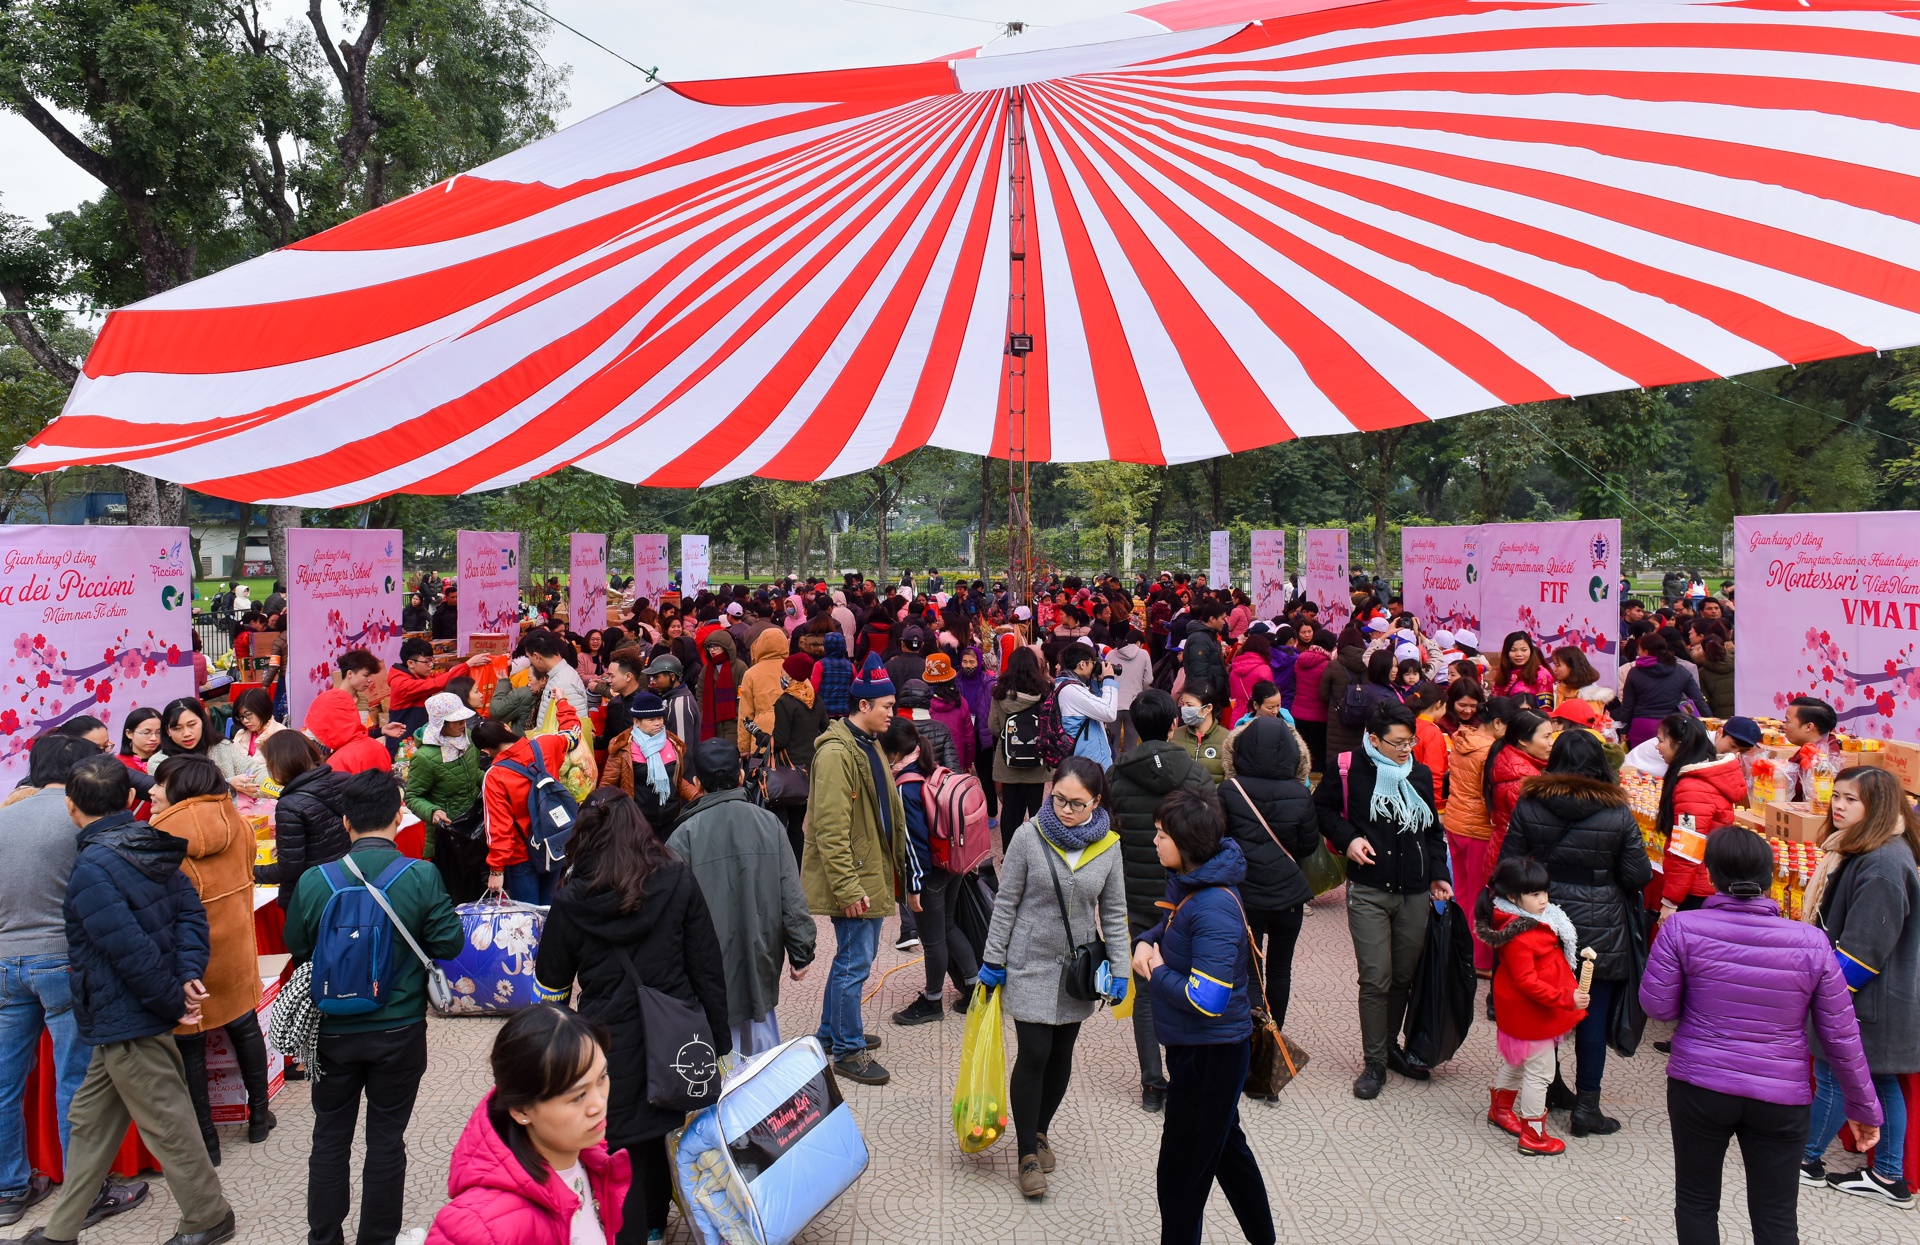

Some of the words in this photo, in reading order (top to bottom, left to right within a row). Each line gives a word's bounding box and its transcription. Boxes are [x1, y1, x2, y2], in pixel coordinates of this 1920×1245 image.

[1750, 531, 1771, 553] Gian
[1771, 531, 1793, 551] hàng
[1802, 531, 1824, 551] đồng
[4, 549, 34, 574] Gian
[35, 549, 62, 570] hàng
[73, 549, 97, 569] đồng
[1491, 555, 1515, 577] Trường
[1532, 563, 1545, 573] non
[1796, 551, 1817, 568] Trung
[1817, 555, 1831, 565] tâm
[1868, 552, 1895, 567] Huấn
[150, 564, 184, 583] Piccioni
[296, 564, 322, 590] Flying
[322, 563, 349, 587] Fingers
[350, 561, 374, 580] School
[1422, 566, 1461, 590] Foreserco
[1766, 559, 1859, 592] Montessori
[1862, 574, 1889, 596] Việt
[1888, 575, 1920, 594] Nam
[18, 573, 51, 602] dei
[56, 569, 135, 601] Piccioni
[1539, 581, 1569, 604] FTF
[73, 612, 92, 620] non
[106, 602, 128, 618] chim
[1841, 598, 1920, 631] VMAT
